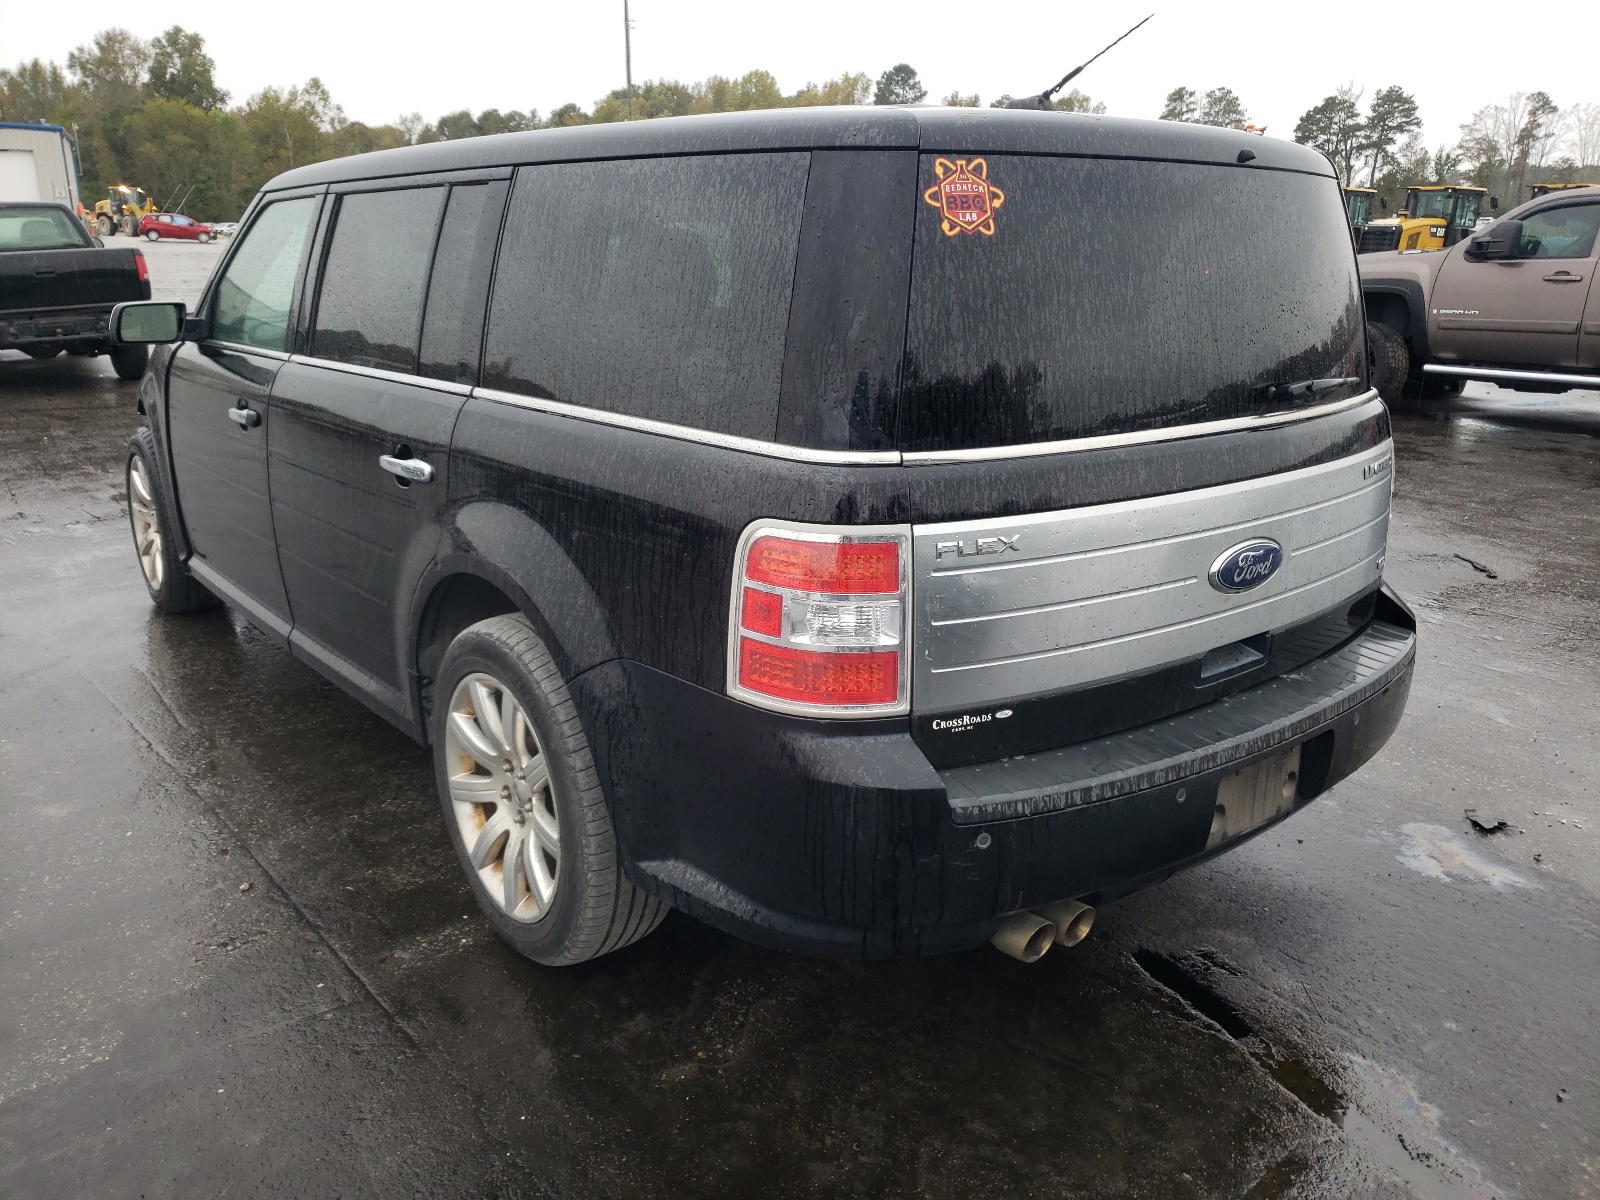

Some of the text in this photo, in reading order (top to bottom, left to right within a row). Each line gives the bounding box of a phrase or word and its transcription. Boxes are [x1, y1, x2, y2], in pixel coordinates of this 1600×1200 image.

[946, 195, 985, 212] BBQ
[959, 213, 977, 221] LAB
[936, 535, 1020, 560] FLEX
[1233, 549, 1274, 582] Ford
